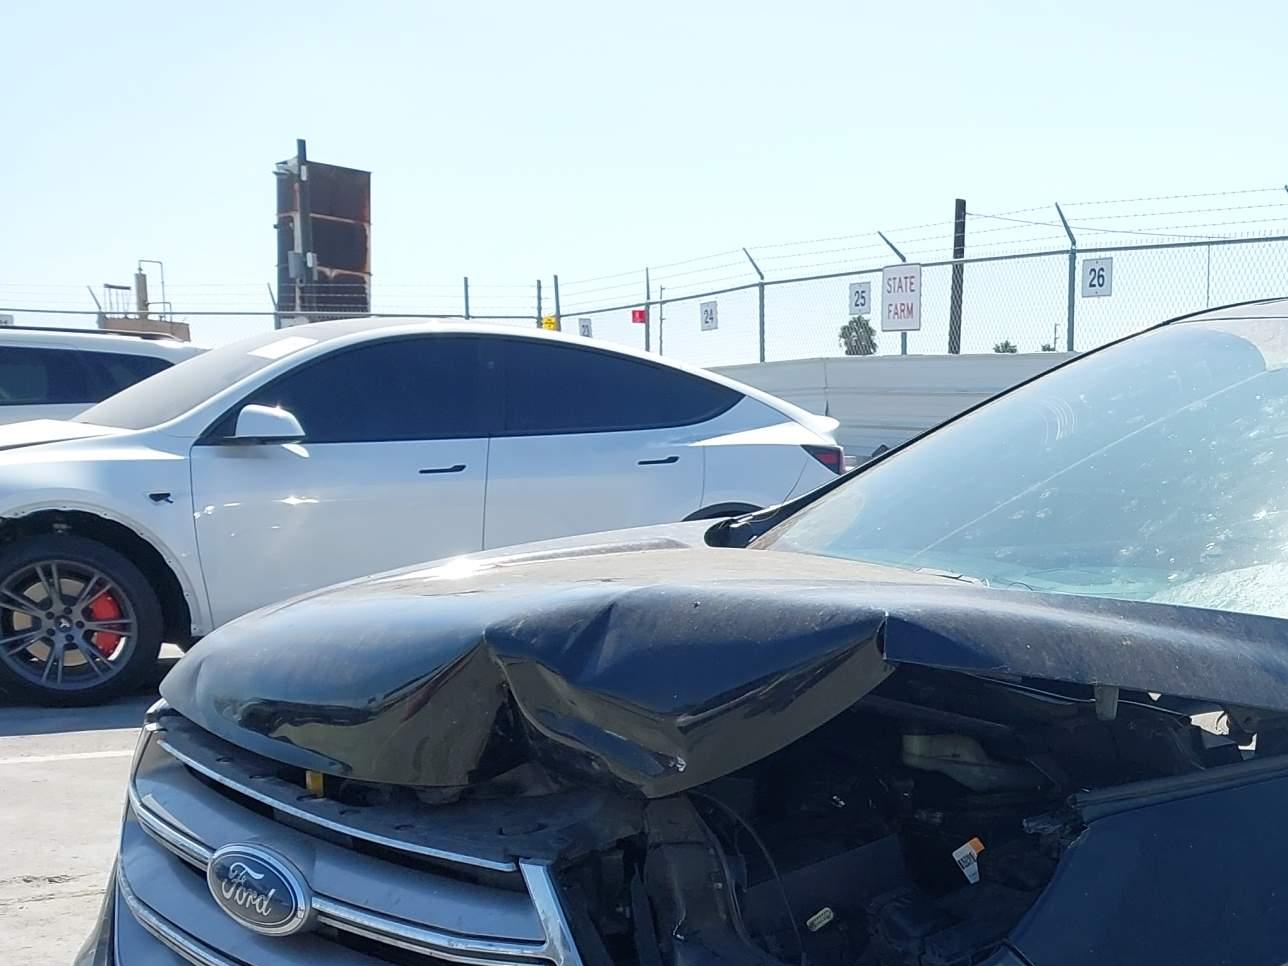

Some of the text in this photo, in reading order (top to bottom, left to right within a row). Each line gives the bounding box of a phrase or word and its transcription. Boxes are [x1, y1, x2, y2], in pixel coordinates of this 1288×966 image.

[885, 274, 916, 295] STATE
[1088, 266, 1106, 289] 26
[853, 290, 867, 308] 25
[703, 308, 715, 325] 24
[887, 302, 914, 321] FARM
[221, 861, 276, 916] Ford
